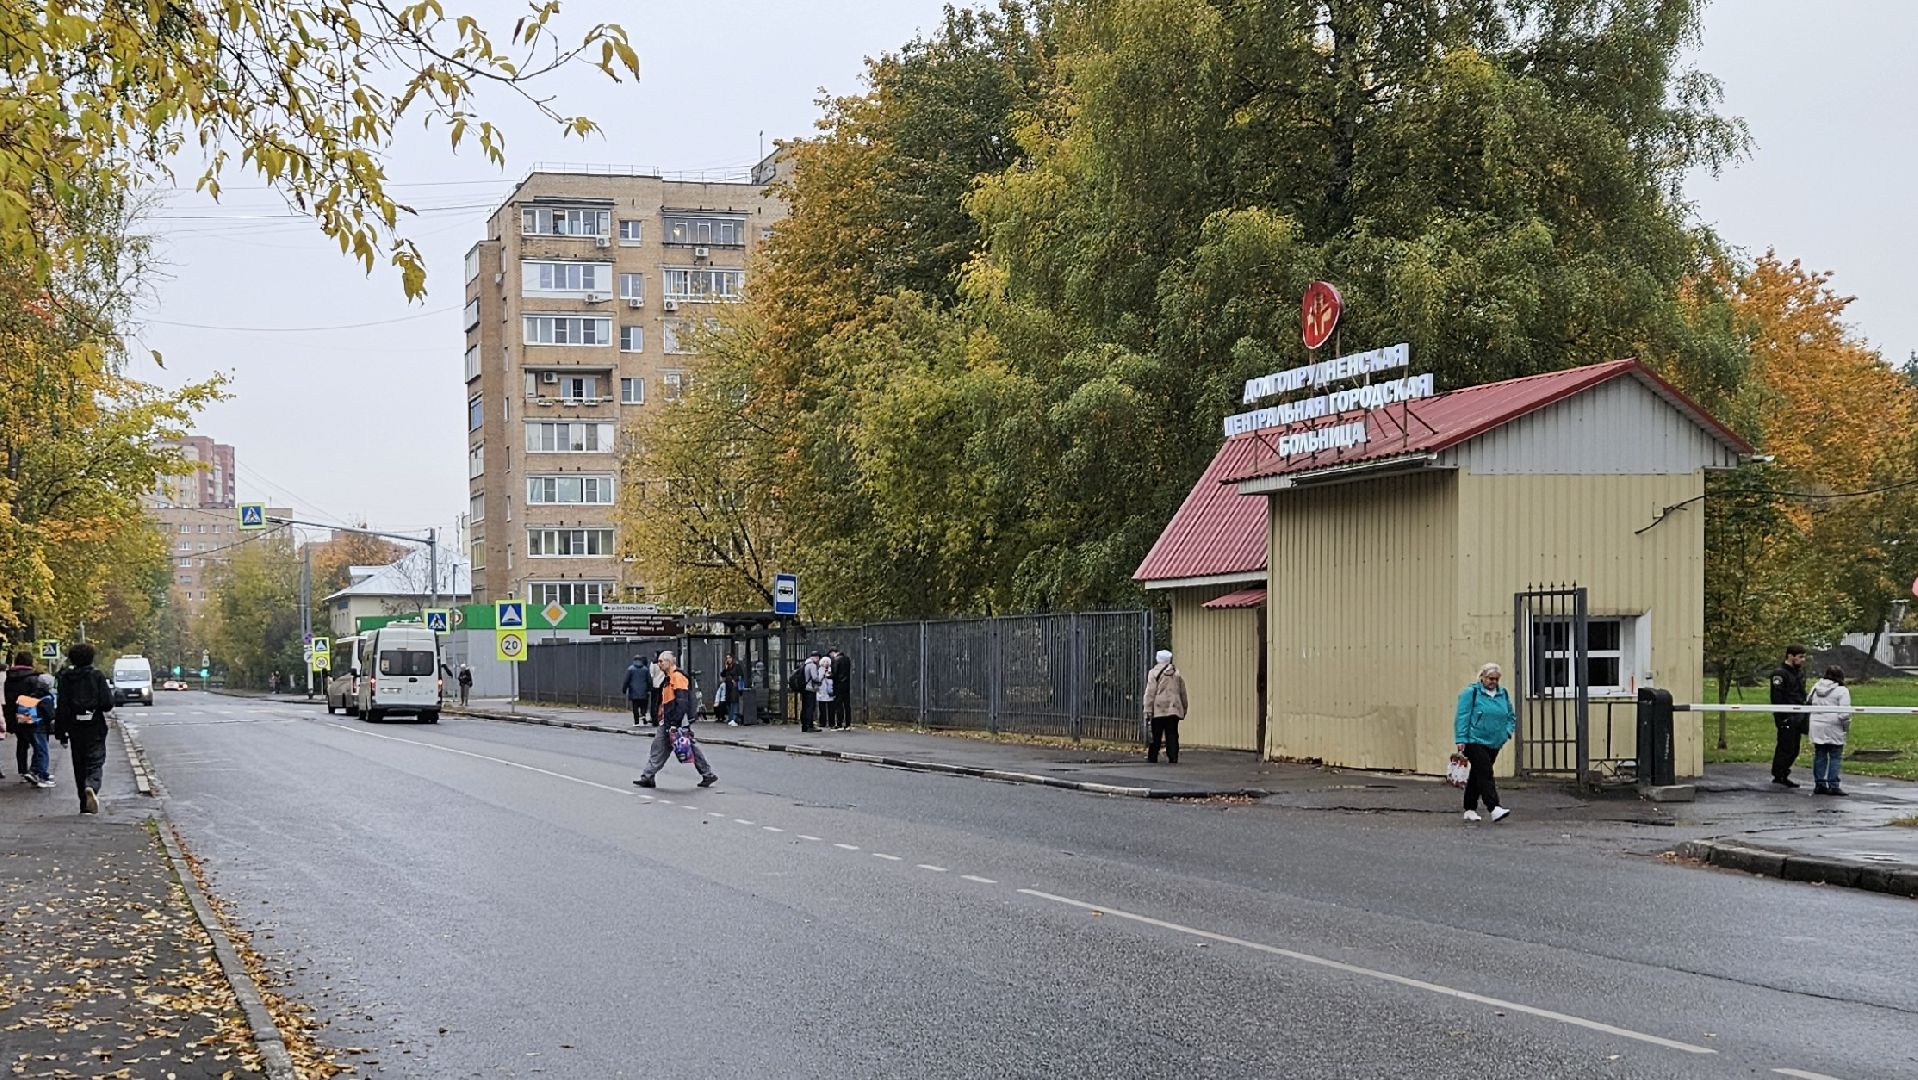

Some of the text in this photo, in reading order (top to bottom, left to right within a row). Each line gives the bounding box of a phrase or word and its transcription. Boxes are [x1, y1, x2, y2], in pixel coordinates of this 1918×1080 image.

[1243, 343, 1409, 404] ДОЛГОПРУДНЕНСКАЯ
[1224, 373, 1434, 437] ЦЕНТРАЛЬНАЯ ГОРОДСКАЯ
[1279, 421, 1367, 457] БОЛЬНИЦА
[505, 640, 518, 650] 20
